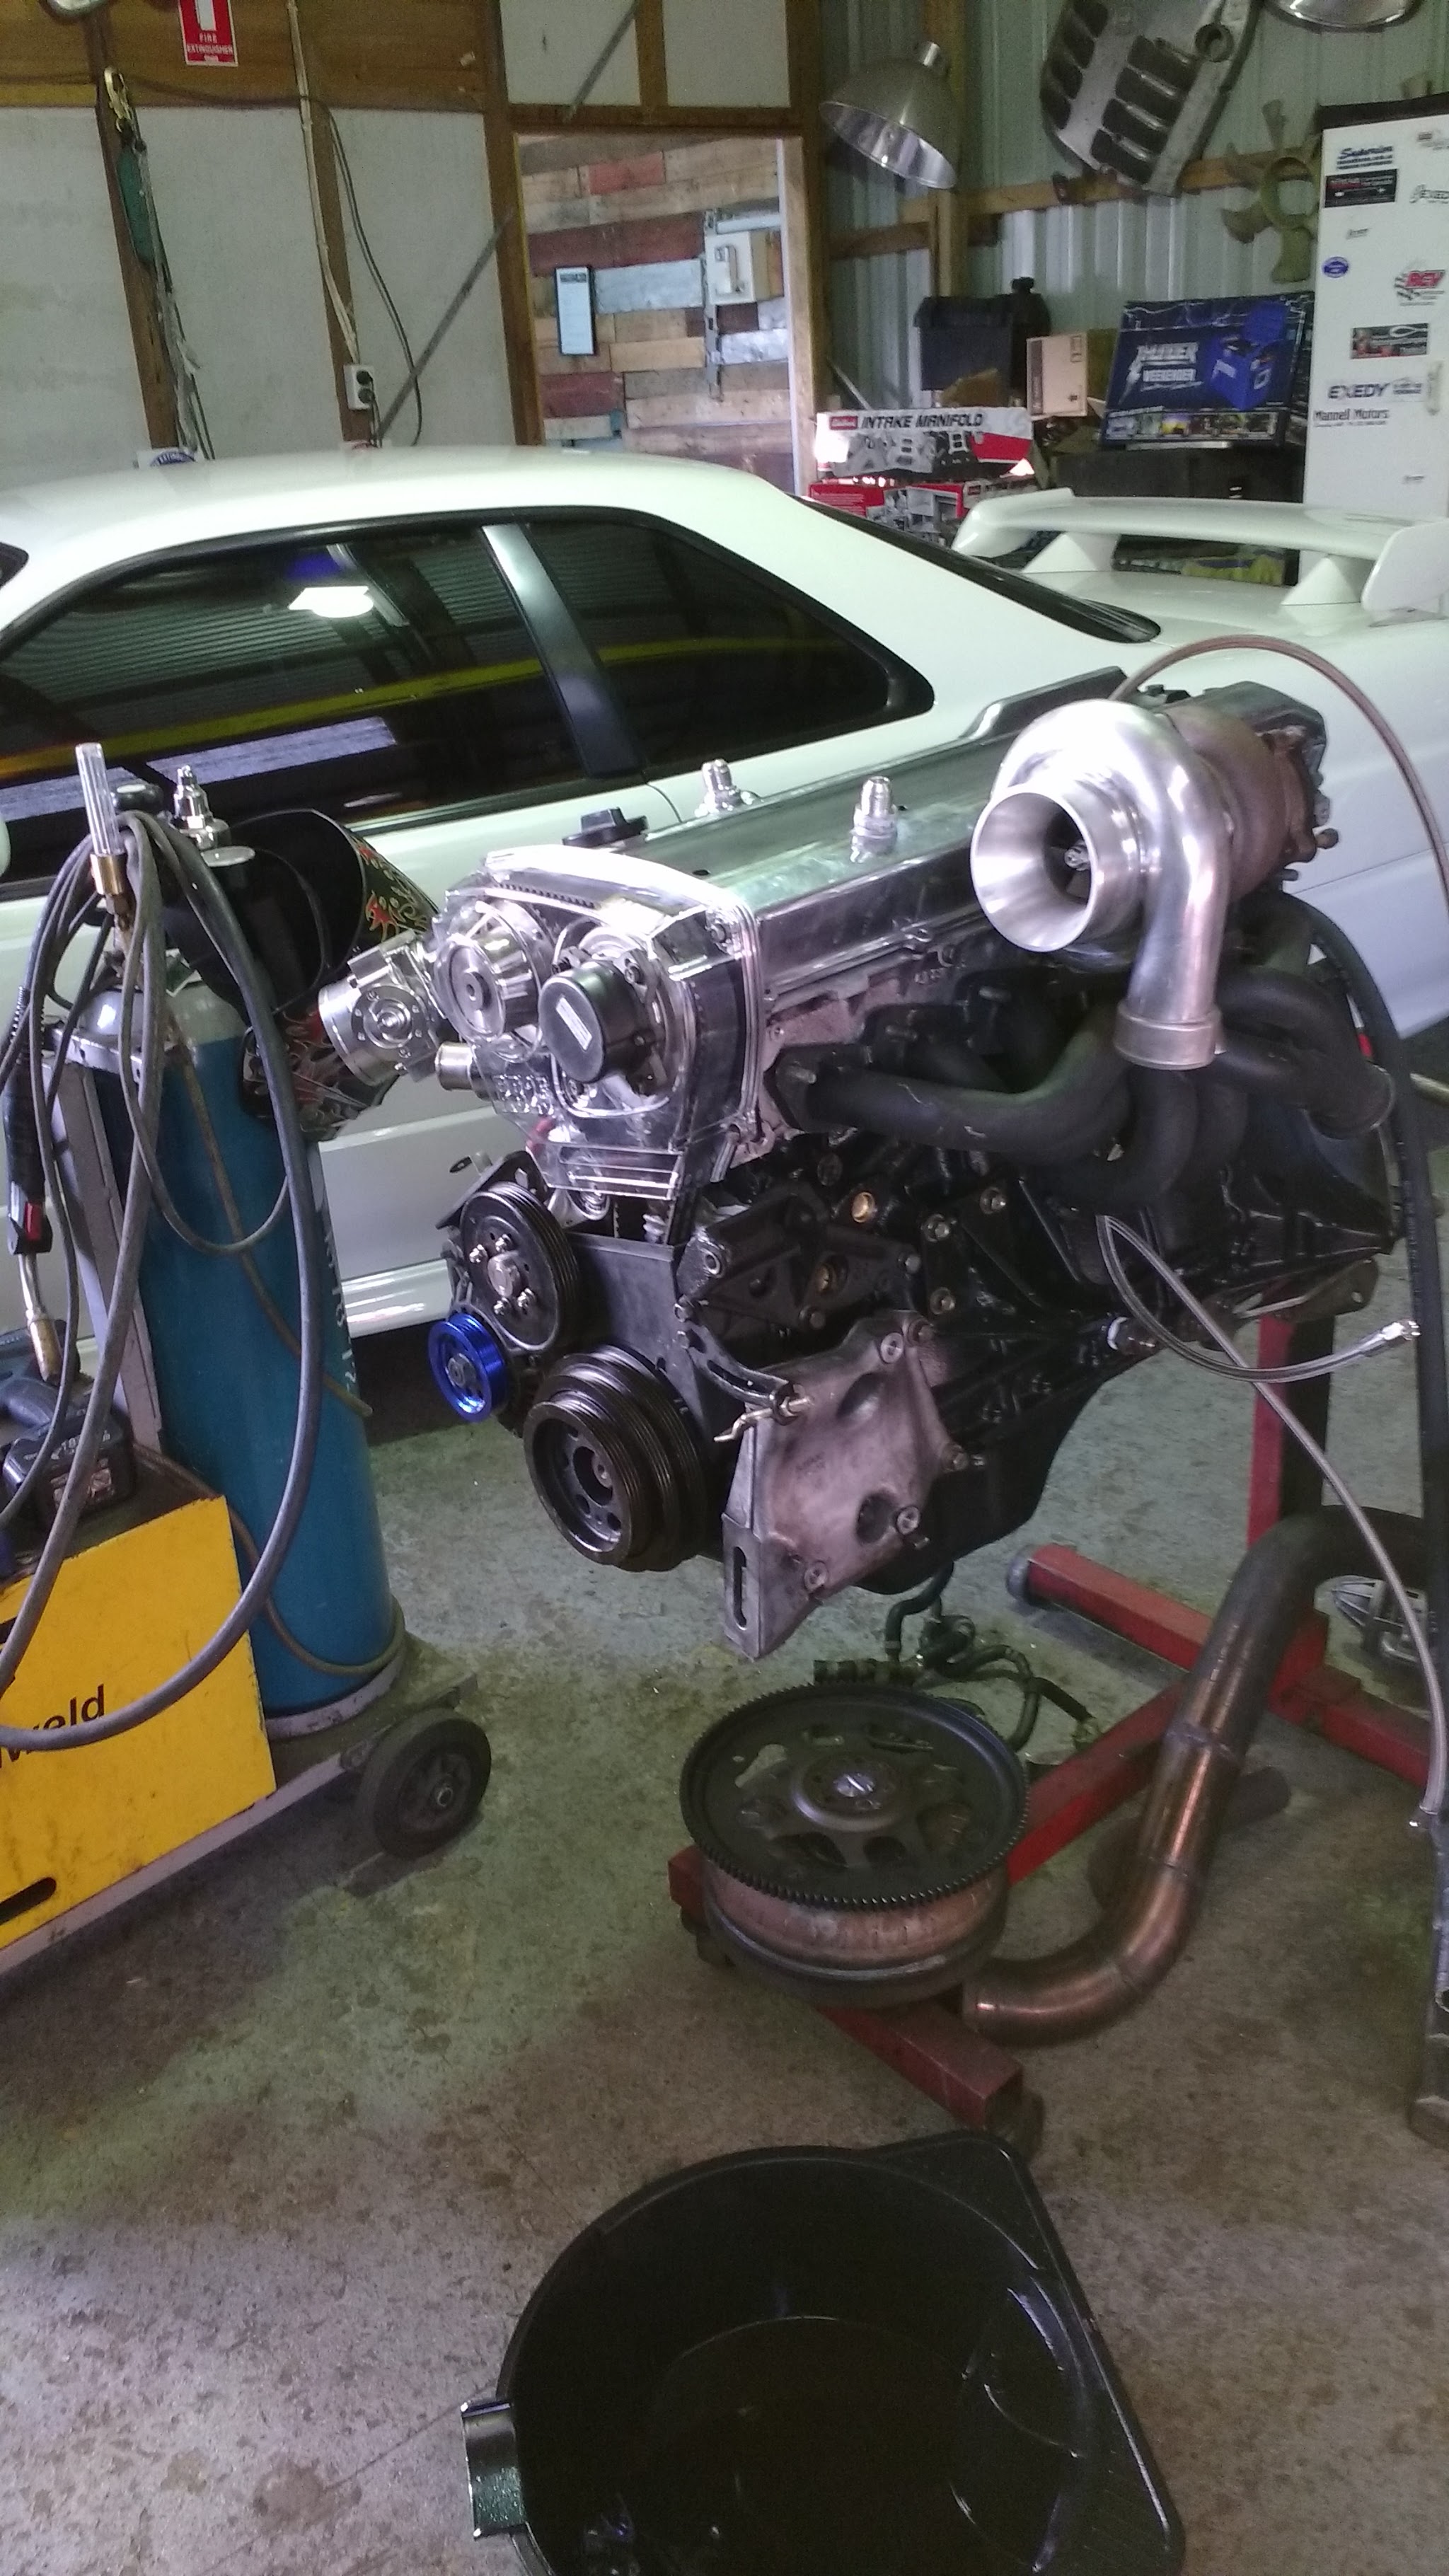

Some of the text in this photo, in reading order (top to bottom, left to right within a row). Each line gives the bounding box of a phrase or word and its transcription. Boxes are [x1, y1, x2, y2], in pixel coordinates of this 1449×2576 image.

[199, 33, 217, 43] FIRE
[187, 44, 233, 54] EXTINGUISHER
[1327, 382, 1390, 399] EXEDY
[860, 415, 913, 429] INTAKE
[915, 413, 983, 428] MANIFOLD
